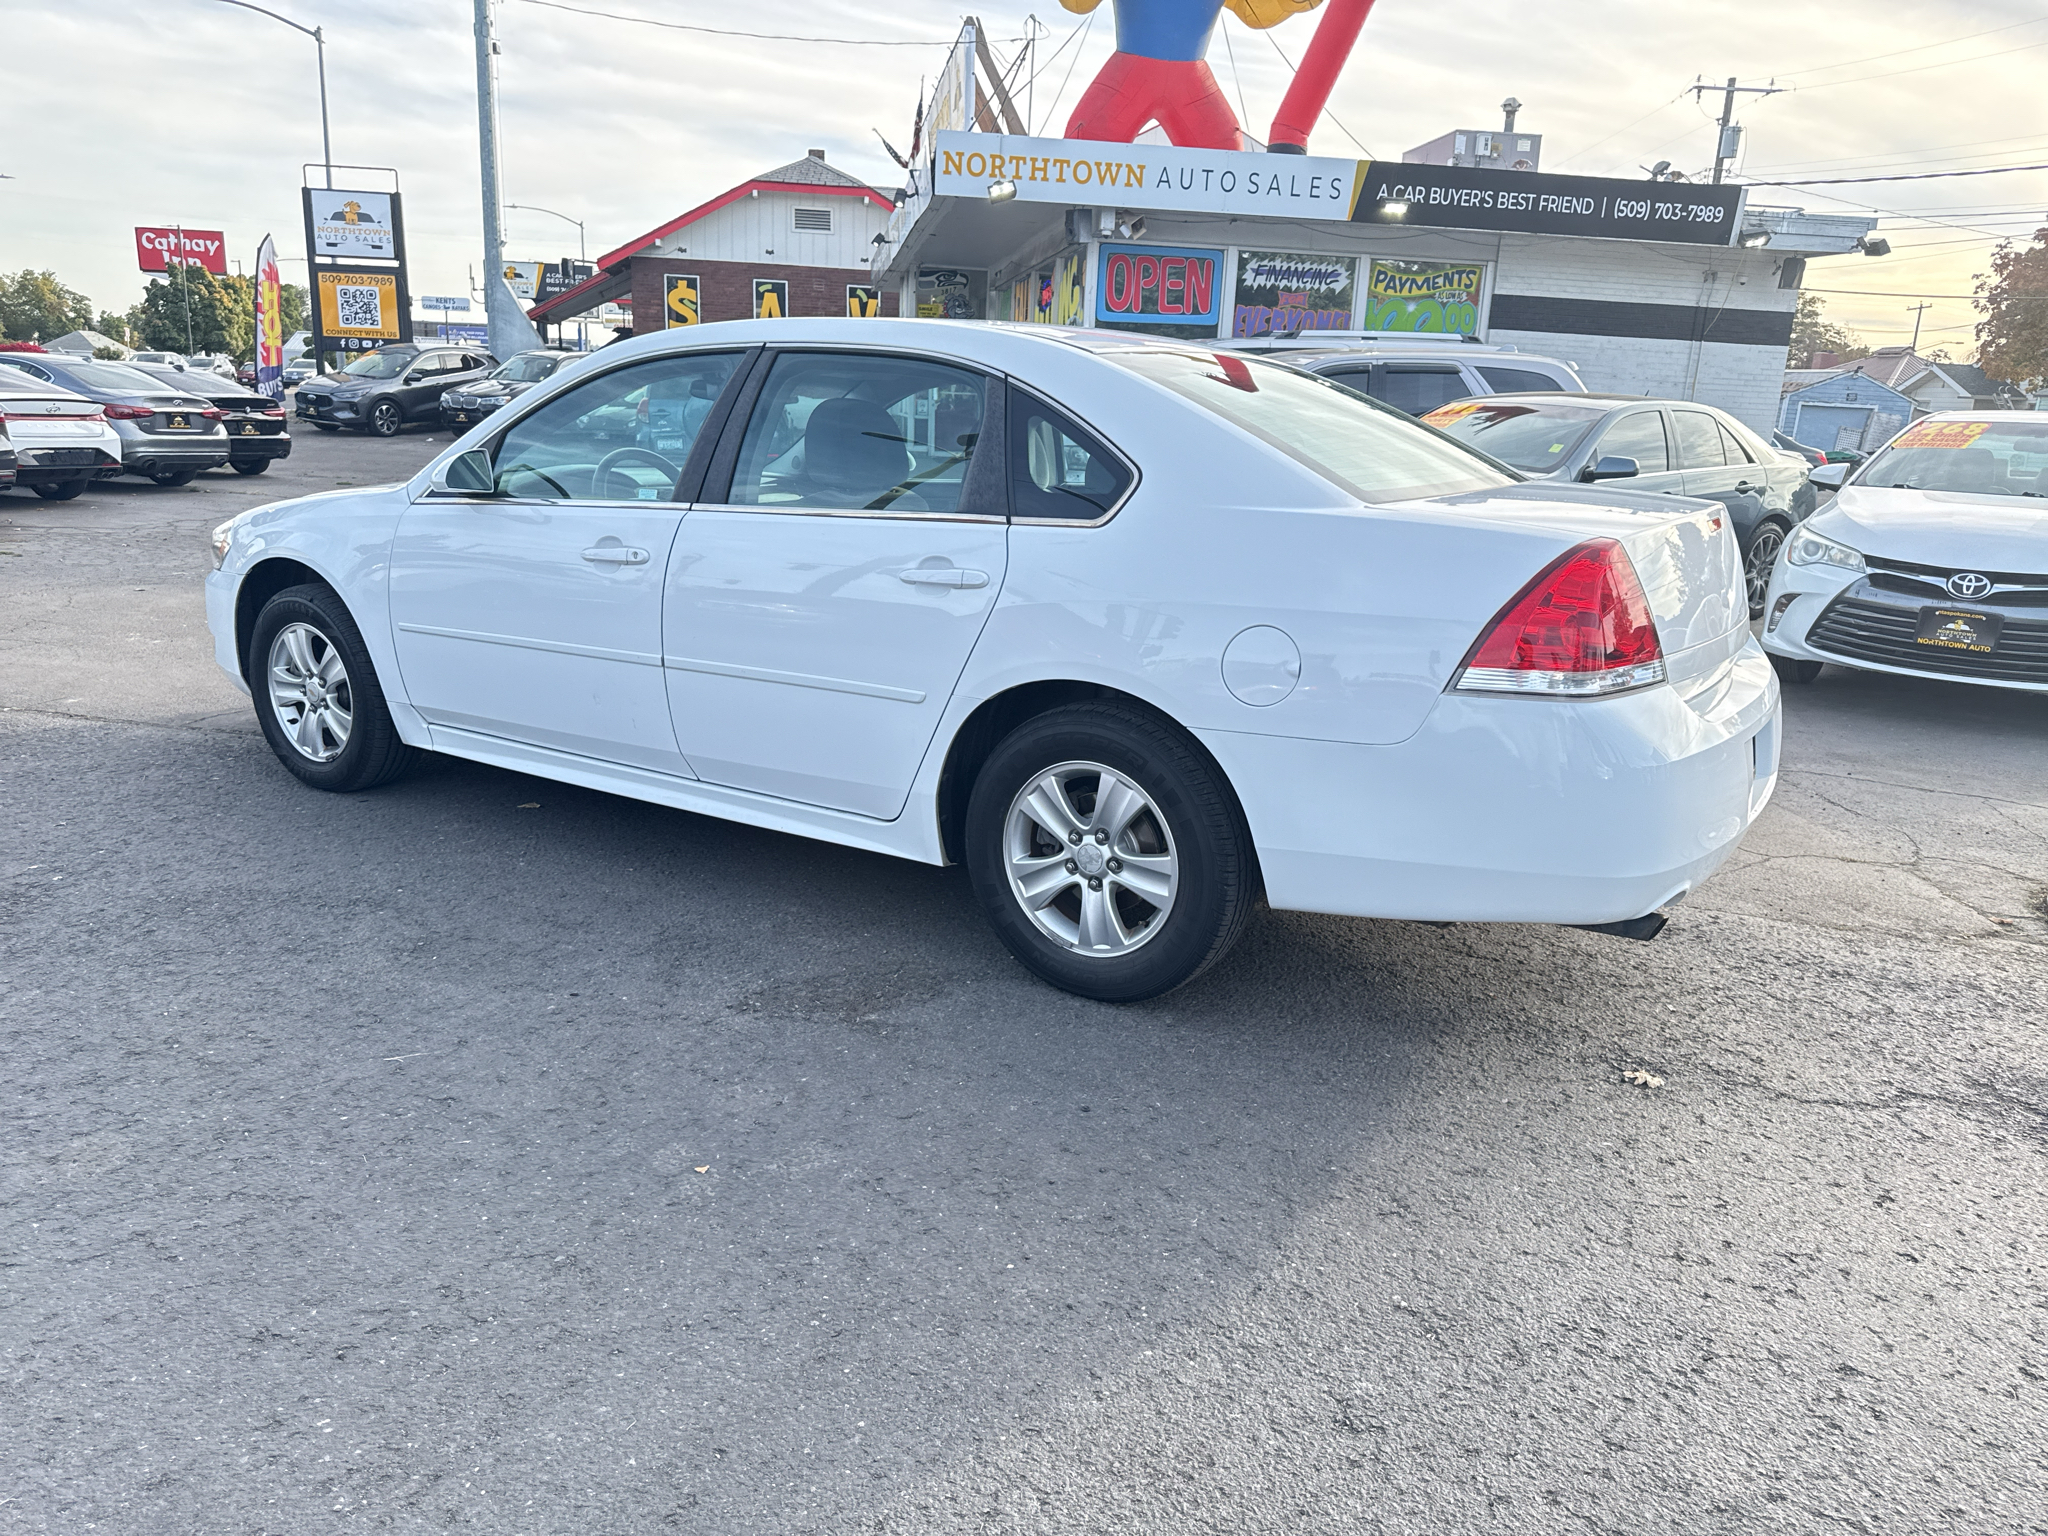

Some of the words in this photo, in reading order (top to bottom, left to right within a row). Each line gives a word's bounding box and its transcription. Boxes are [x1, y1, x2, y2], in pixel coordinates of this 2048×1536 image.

[943, 150, 1146, 189] NORTHTOWN
[1156, 166, 1236, 193] AUTO
[1247, 172, 1342, 200] SALES
[1376, 183, 1389, 200] A
[1393, 184, 1426, 204] CAR
[1429, 187, 1494, 208] BUYER'S
[1497, 191, 1537, 211] BEST
[1538, 194, 1594, 215] FRIEND
[1614, 197, 1650, 221] (509)
[1654, 202, 1725, 223] 703-7989
[317, 226, 391, 236] NORTHTOWN
[354, 236, 392, 244] SALES
[141, 232, 220, 257] Cathay
[321, 274, 394, 286] 509-703-7989
[1253, 263, 1340, 286] FINANCING
[1373, 269, 1478, 294] PAYMENTS
[1105, 254, 1213, 315] OPEN
[436, 297, 456, 305] KENTS
[1281, 294, 1304, 304] FOR
[262, 280, 283, 367] HOT
[325, 329, 363, 337] CONNECT
[258, 376, 284, 397] BUYS
[1937, 629, 1977, 637] NORTHTOWN
[1917, 638, 1967, 649] NORTHTOWN
[1968, 644, 1991, 653] AUTO
